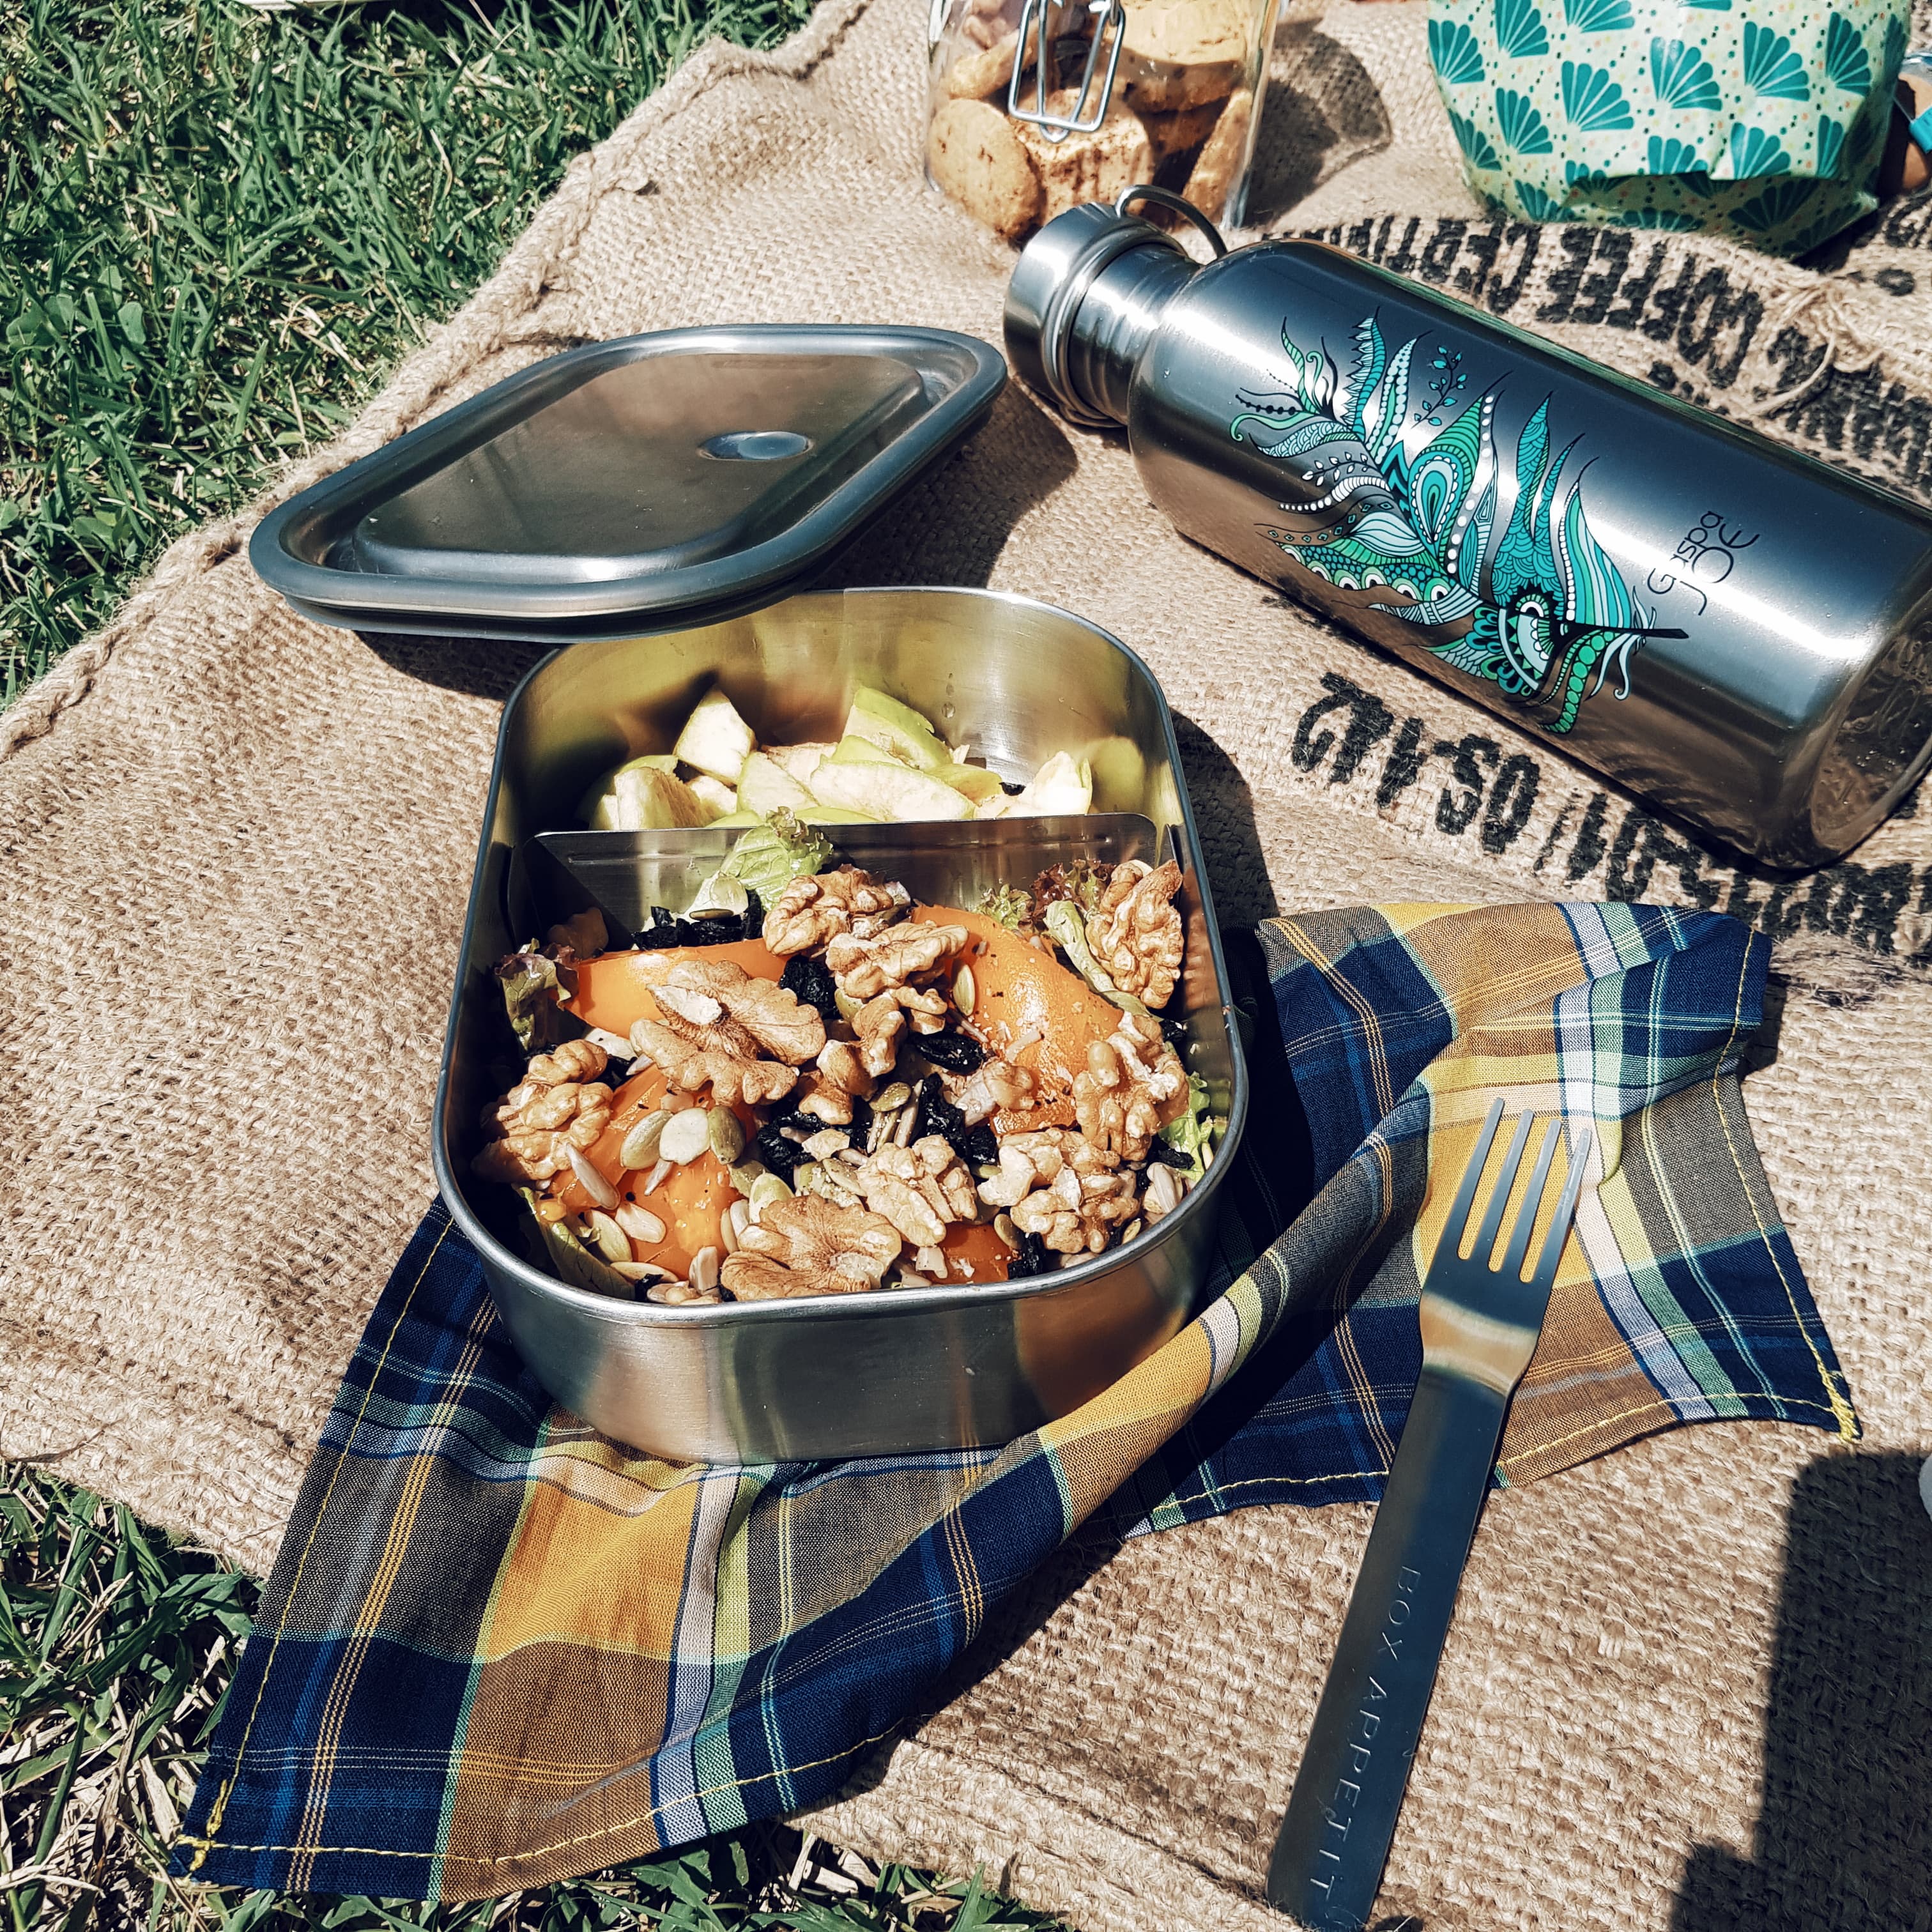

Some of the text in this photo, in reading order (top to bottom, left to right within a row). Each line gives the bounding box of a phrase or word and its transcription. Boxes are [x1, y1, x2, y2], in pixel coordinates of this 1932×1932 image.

[1535, 226, 1765, 389] COFFEE
[1310, 1566, 1421, 1901] BOX APPETIT
